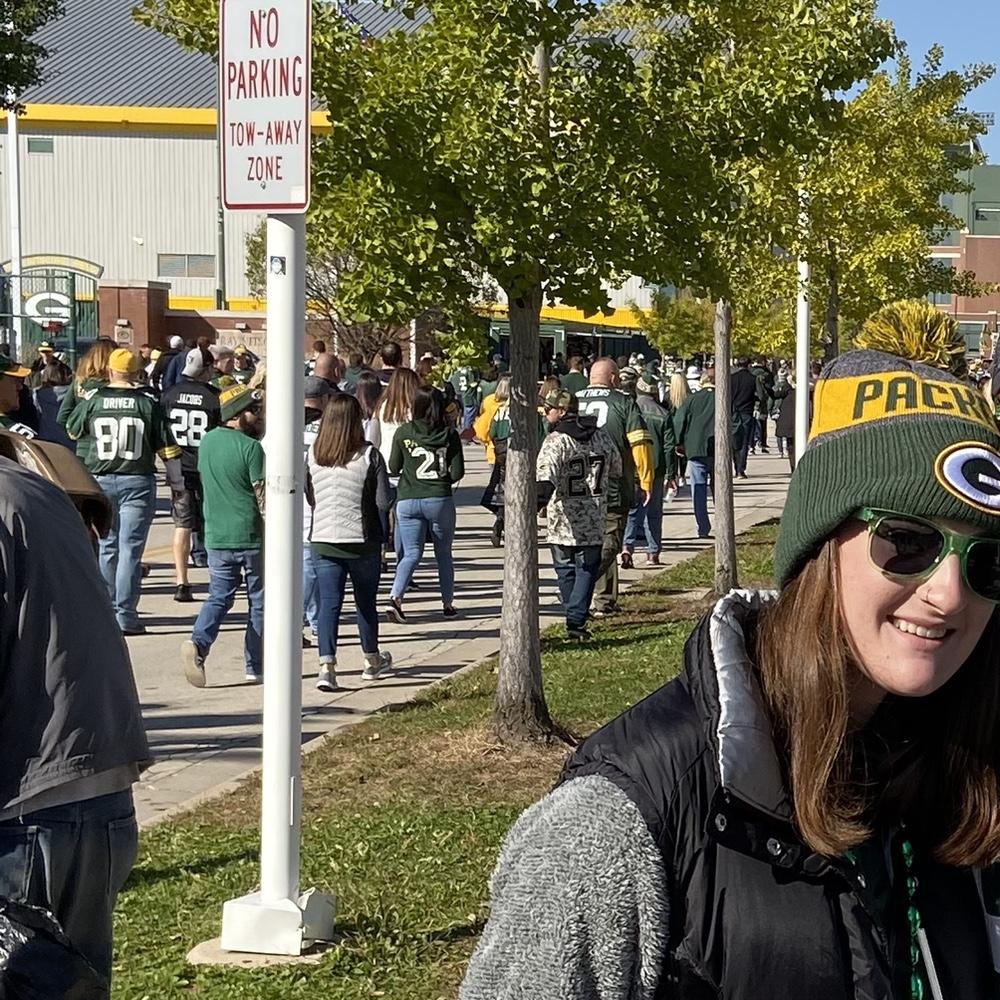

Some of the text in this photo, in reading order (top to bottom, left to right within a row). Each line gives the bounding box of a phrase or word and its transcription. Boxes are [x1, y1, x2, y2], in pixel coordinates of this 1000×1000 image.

[250, 7, 279, 49] NO
[227, 55, 302, 100] PARKING
[229, 119, 302, 147] TOW-AWAY
[247, 156, 283, 181] ZONE
[103, 397, 135, 409] DRIVER
[852, 376, 990, 424] PACK
[94, 416, 145, 460] 80
[170, 408, 208, 447] 28
[411, 446, 447, 479] 21
[568, 455, 606, 497] 27
